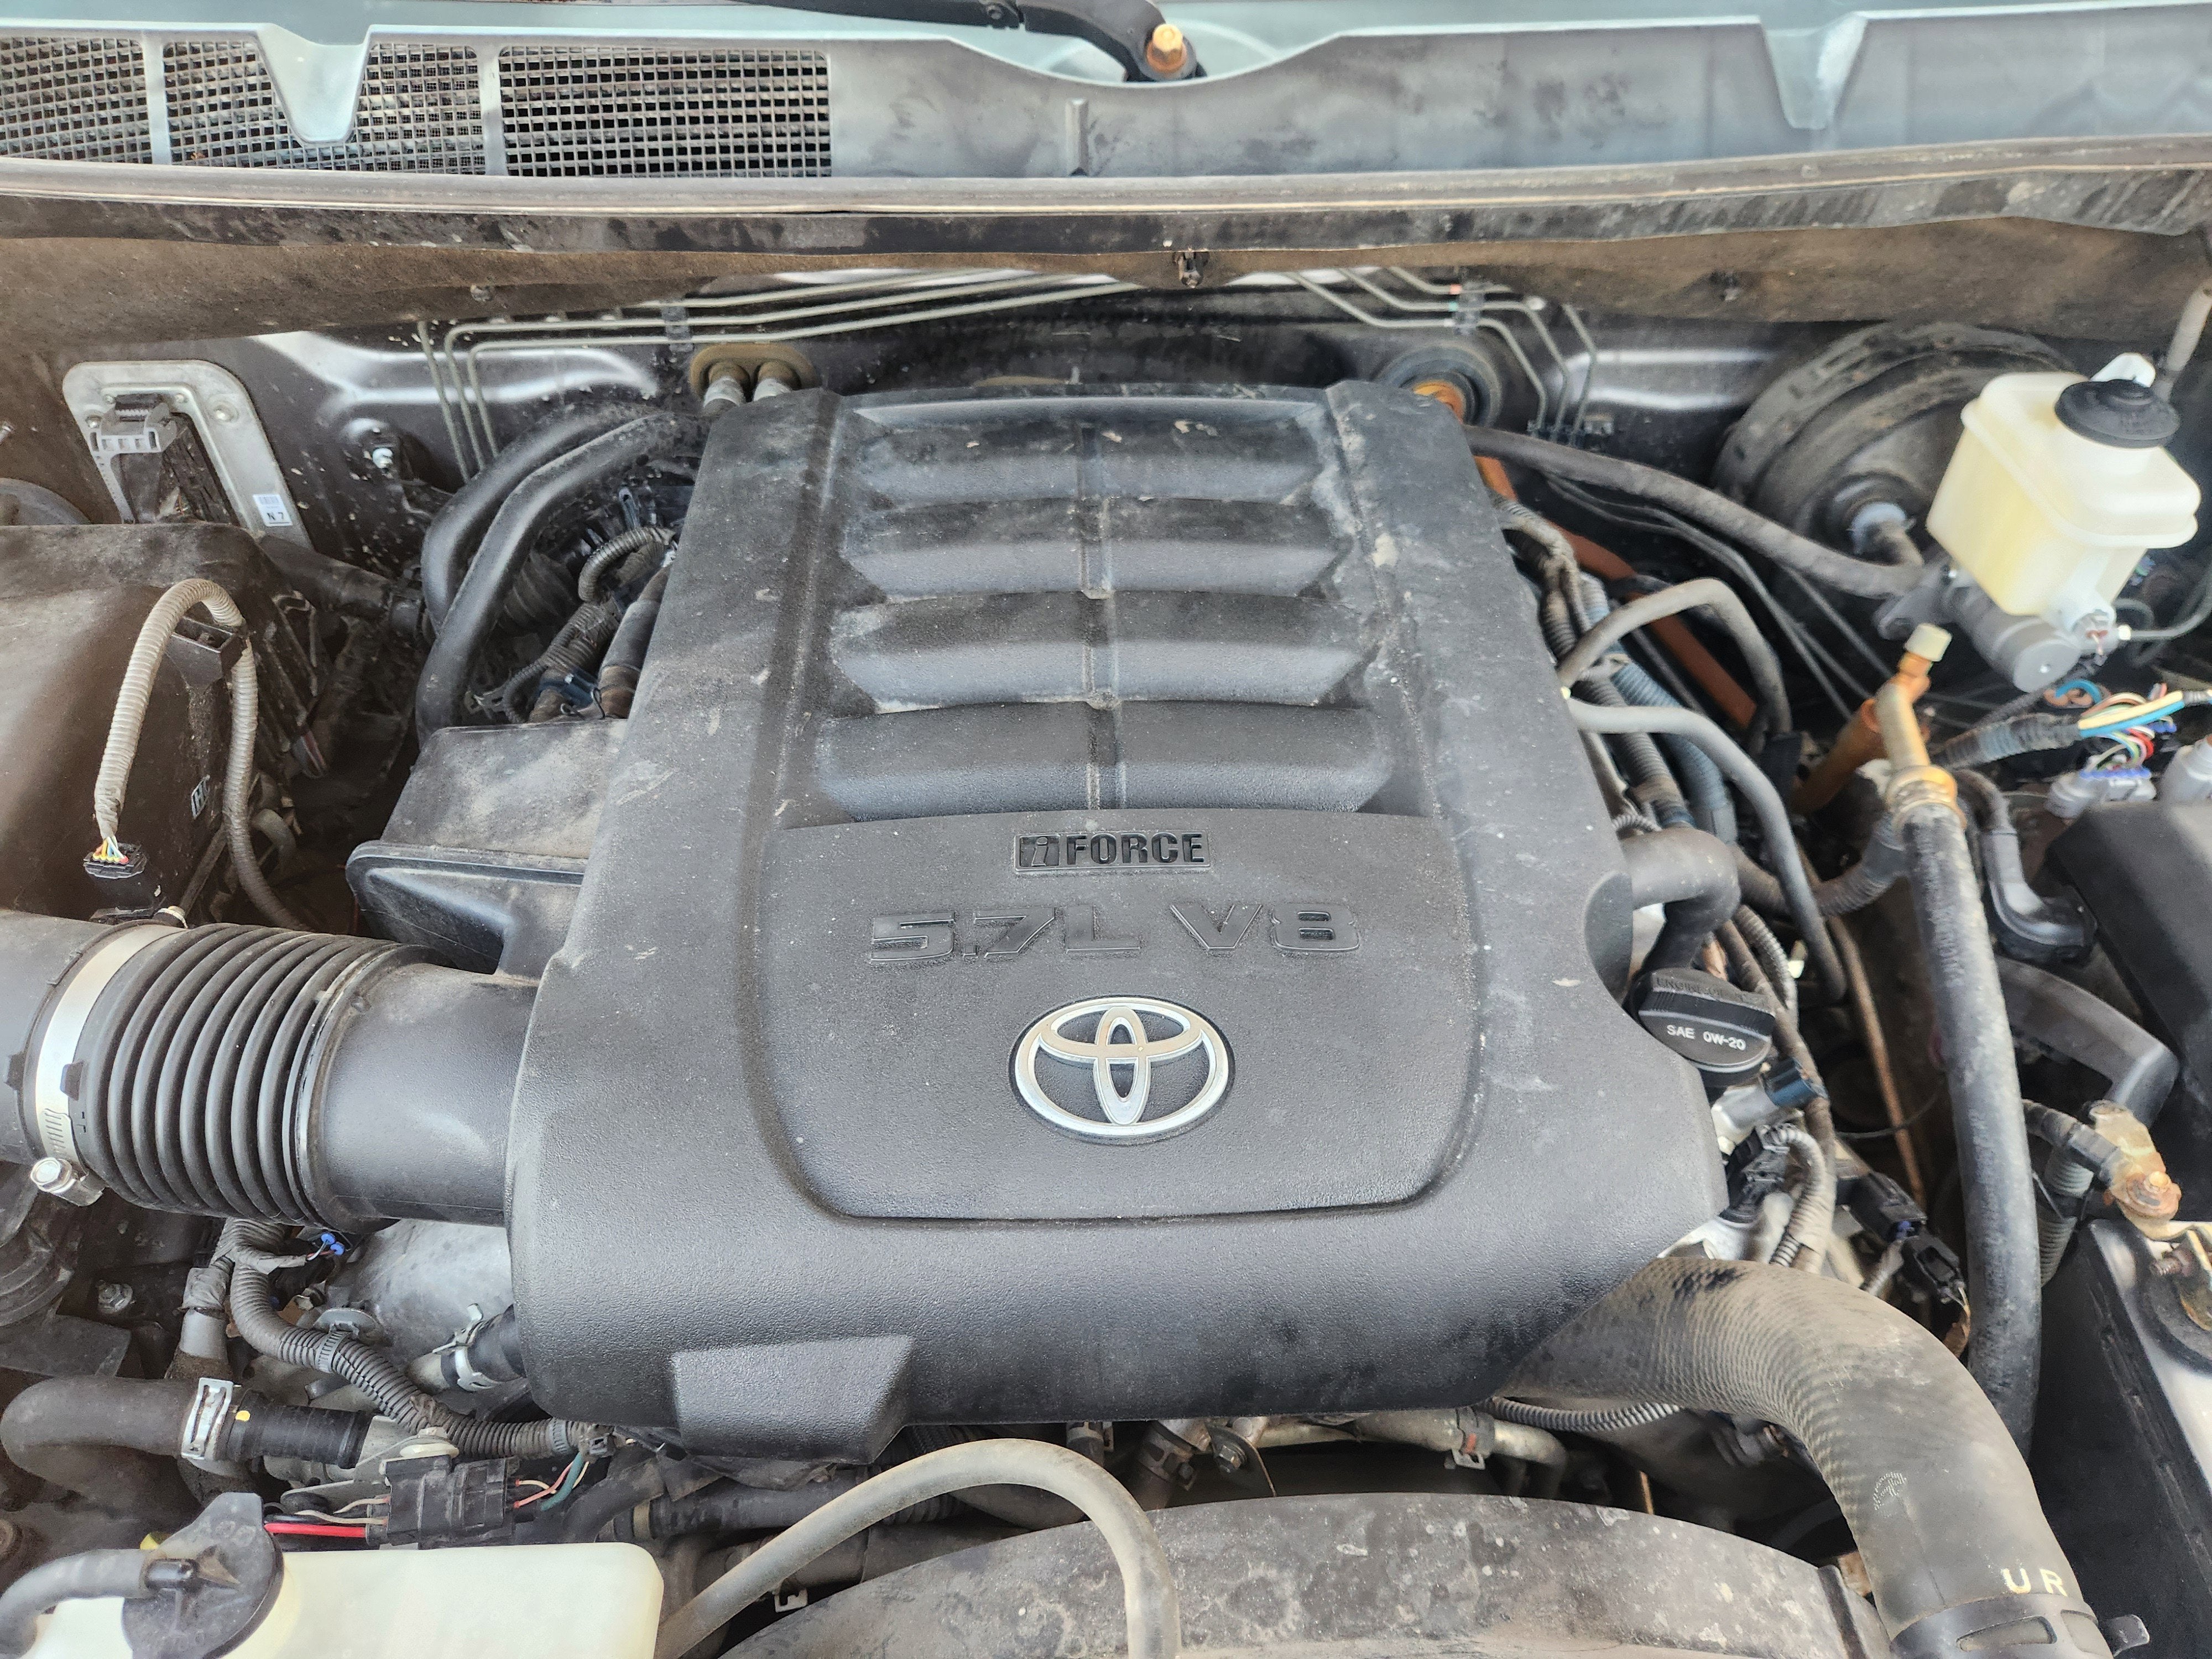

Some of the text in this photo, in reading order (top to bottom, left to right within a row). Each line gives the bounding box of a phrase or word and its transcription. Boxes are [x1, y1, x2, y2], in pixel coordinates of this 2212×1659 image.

[870, 903, 1359, 961] 5.7L V8
[1667, 1024, 1746, 1051] SAE 0W-20
